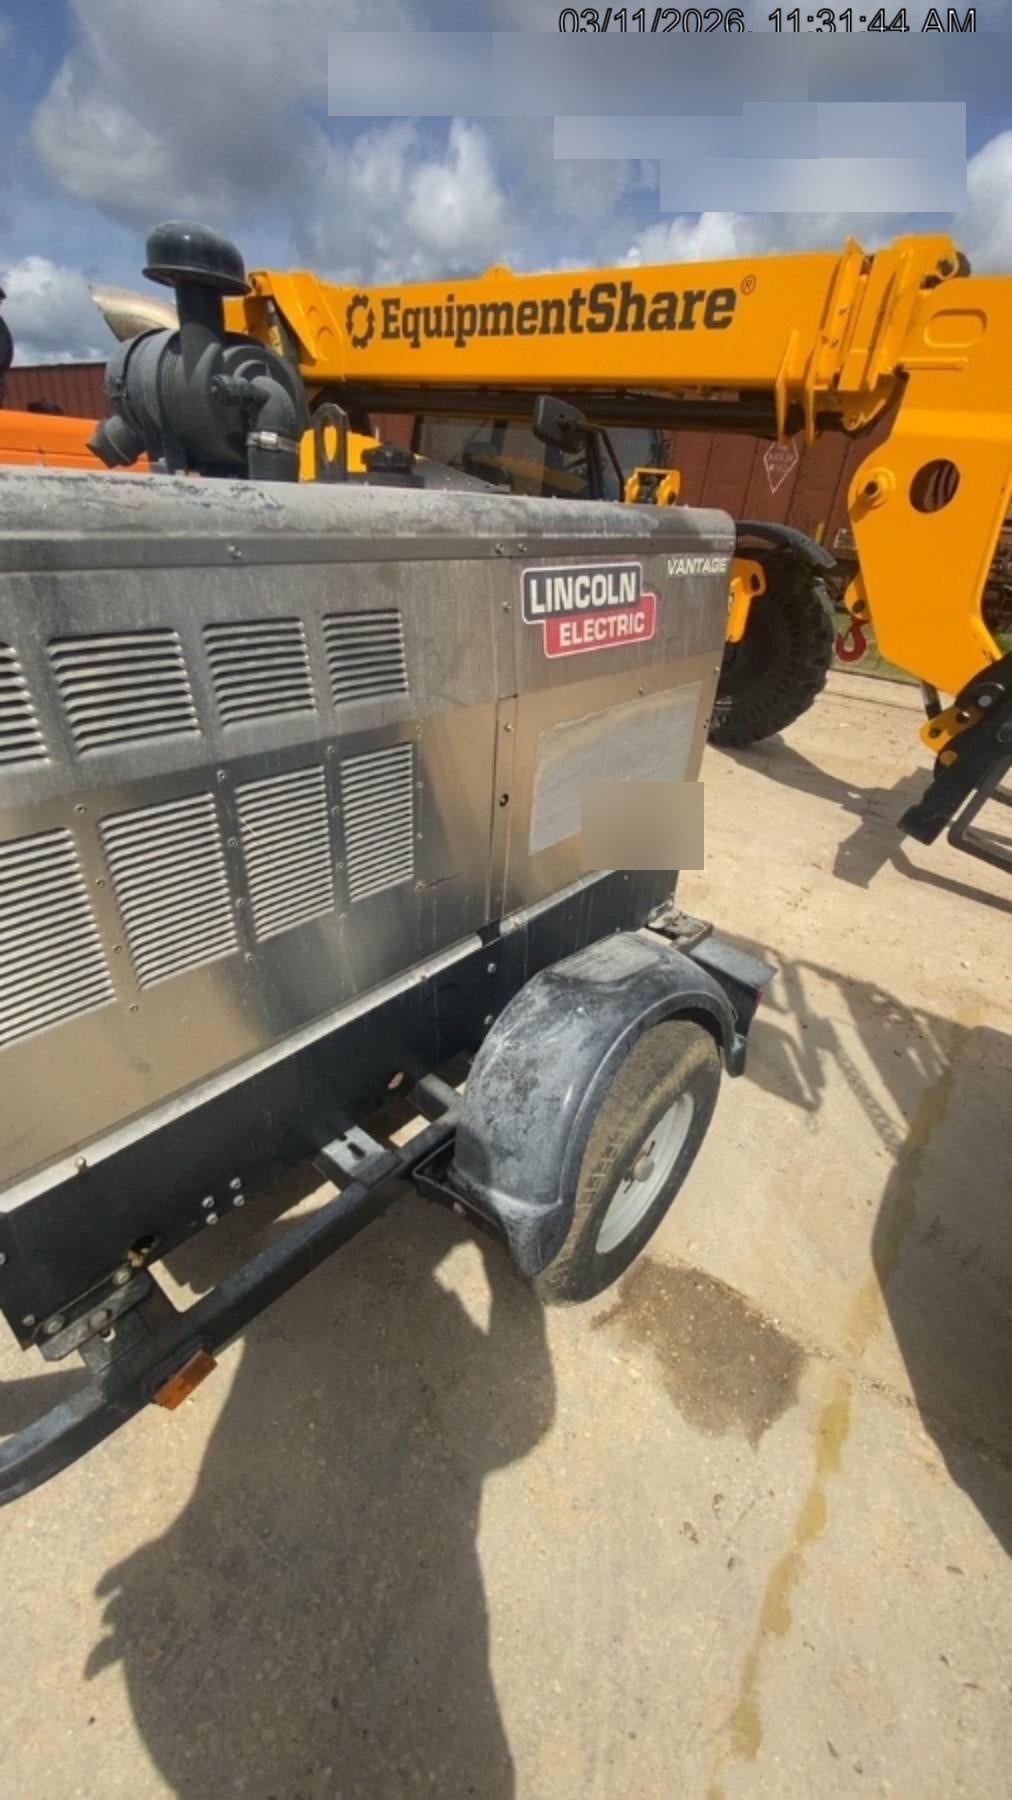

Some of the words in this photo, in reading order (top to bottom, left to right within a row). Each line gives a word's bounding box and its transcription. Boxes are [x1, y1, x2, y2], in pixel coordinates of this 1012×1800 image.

[667, 557, 728, 576] VANTAGE
[530, 572, 637, 614] LINCOLN
[559, 611, 645, 647] ELECTRIC
